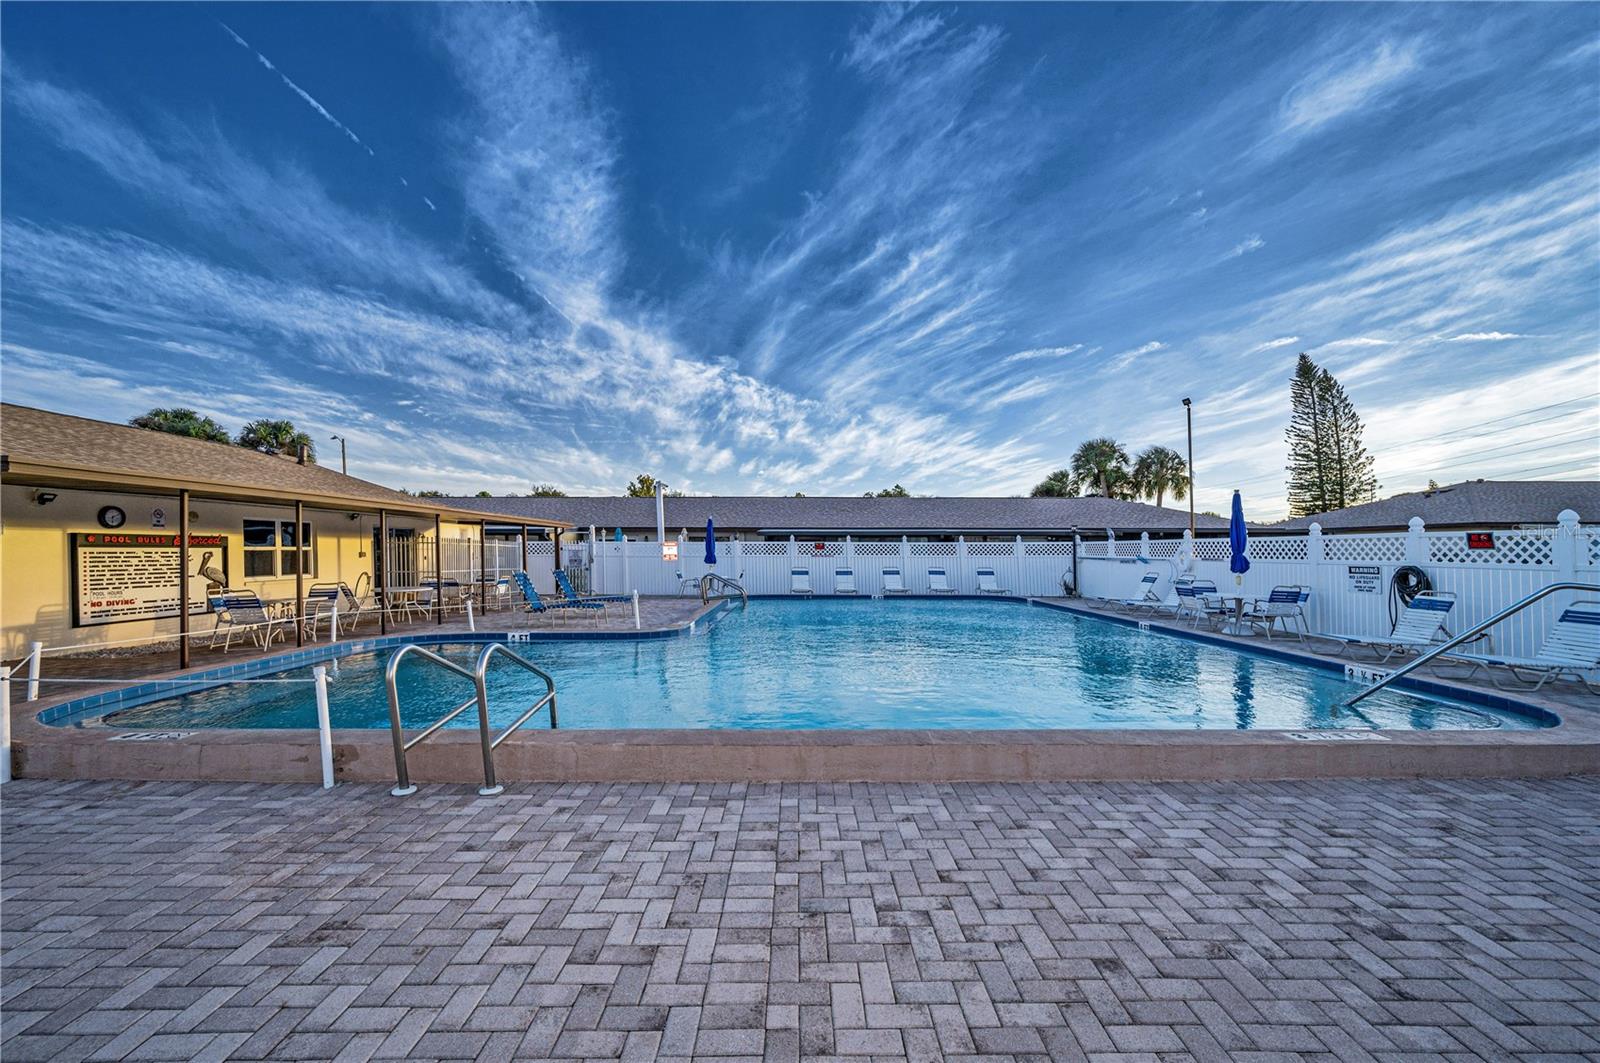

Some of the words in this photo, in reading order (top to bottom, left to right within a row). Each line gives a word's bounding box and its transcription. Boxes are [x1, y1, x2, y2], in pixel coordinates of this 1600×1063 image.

[104, 536, 131, 544] POOL
[137, 536, 167, 545] RULES
[173, 532, 222, 546] Eforced
